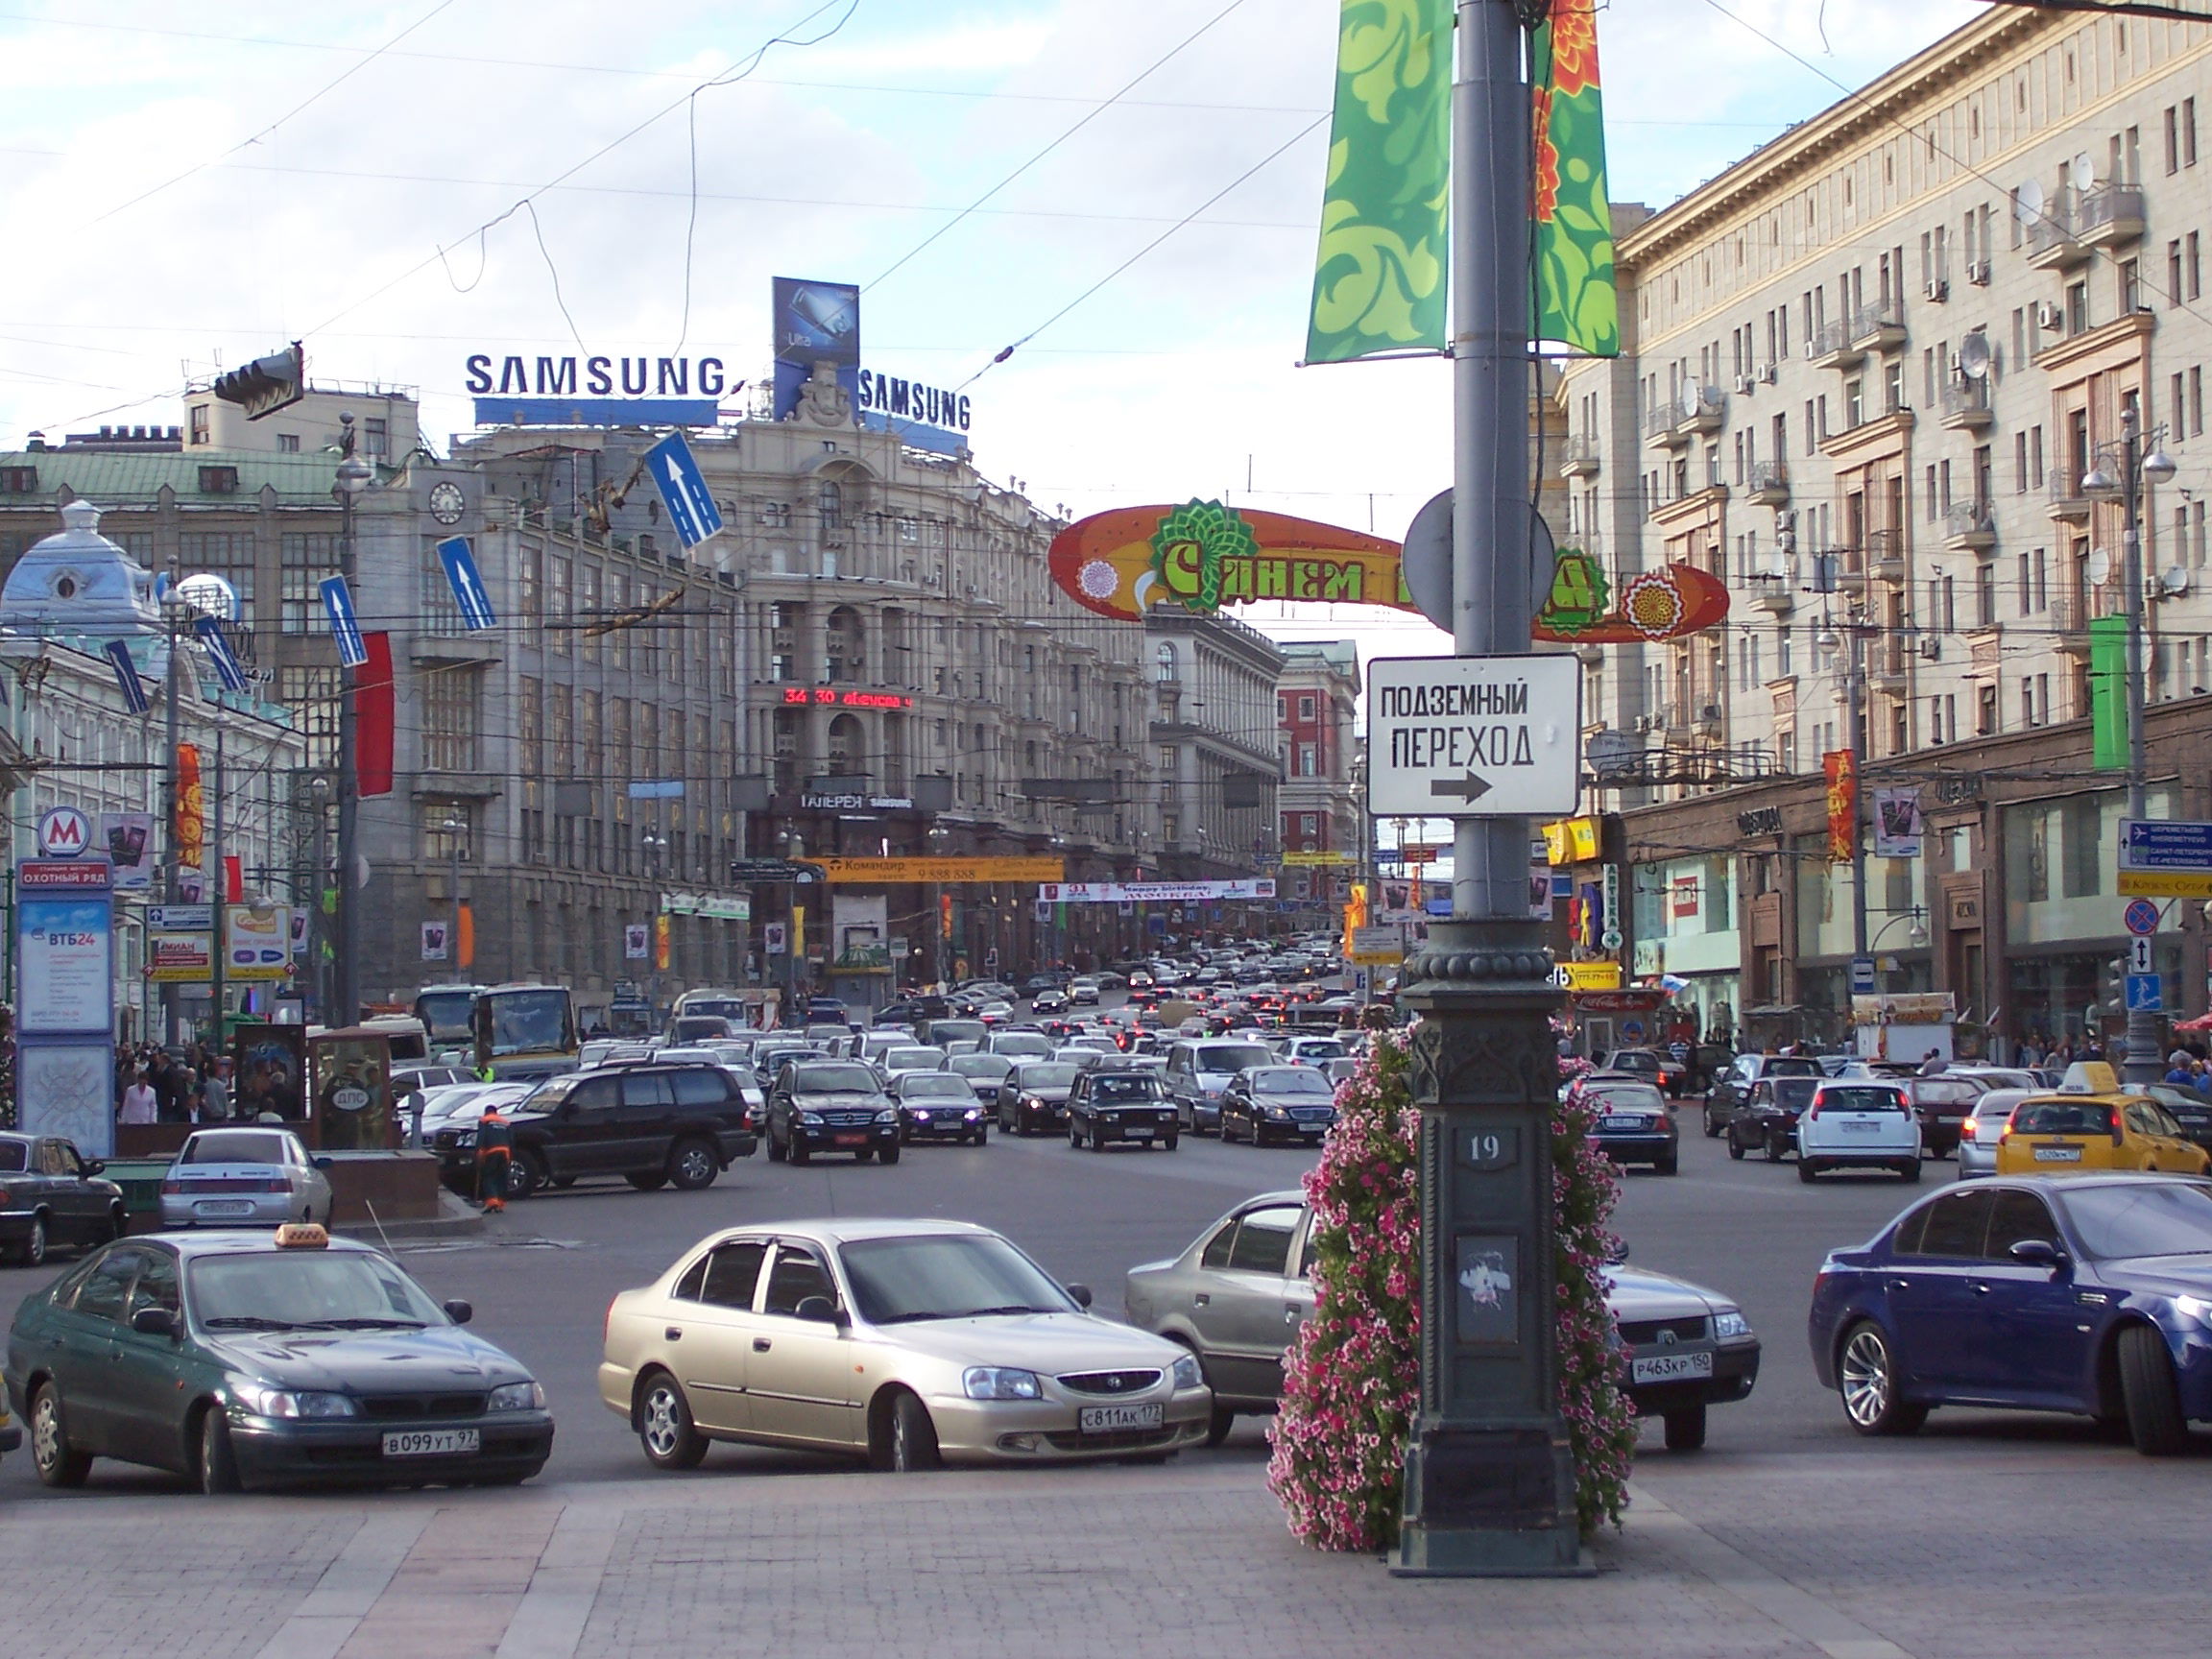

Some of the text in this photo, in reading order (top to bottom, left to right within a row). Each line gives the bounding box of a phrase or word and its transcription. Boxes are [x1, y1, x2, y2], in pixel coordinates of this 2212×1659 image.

[465, 354, 724, 396] SAMSUNG
[858, 369, 971, 431] SAMSUNG
[814, 689, 835, 704] 30
[1381, 676, 1528, 717] ПОДЗЕМНЫЙ
[1391, 724, 1535, 768] ПЕРЕХОД
[47, 815, 82, 845] М
[24, 873, 107, 883] ОХОТНЫЙ РЯД
[1608, 864, 1618, 928] АПТЕКА
[49, 932, 96, 946] ВТБ24
[337, 1093, 365, 1104] ДПС
[1471, 1136, 1499, 1160] 19
[1637, 1353, 1709, 1378] Р463КР 150
[1084, 1408, 1138, 1427] С811АК
[389, 1430, 473, 1453] В099УТ 97
